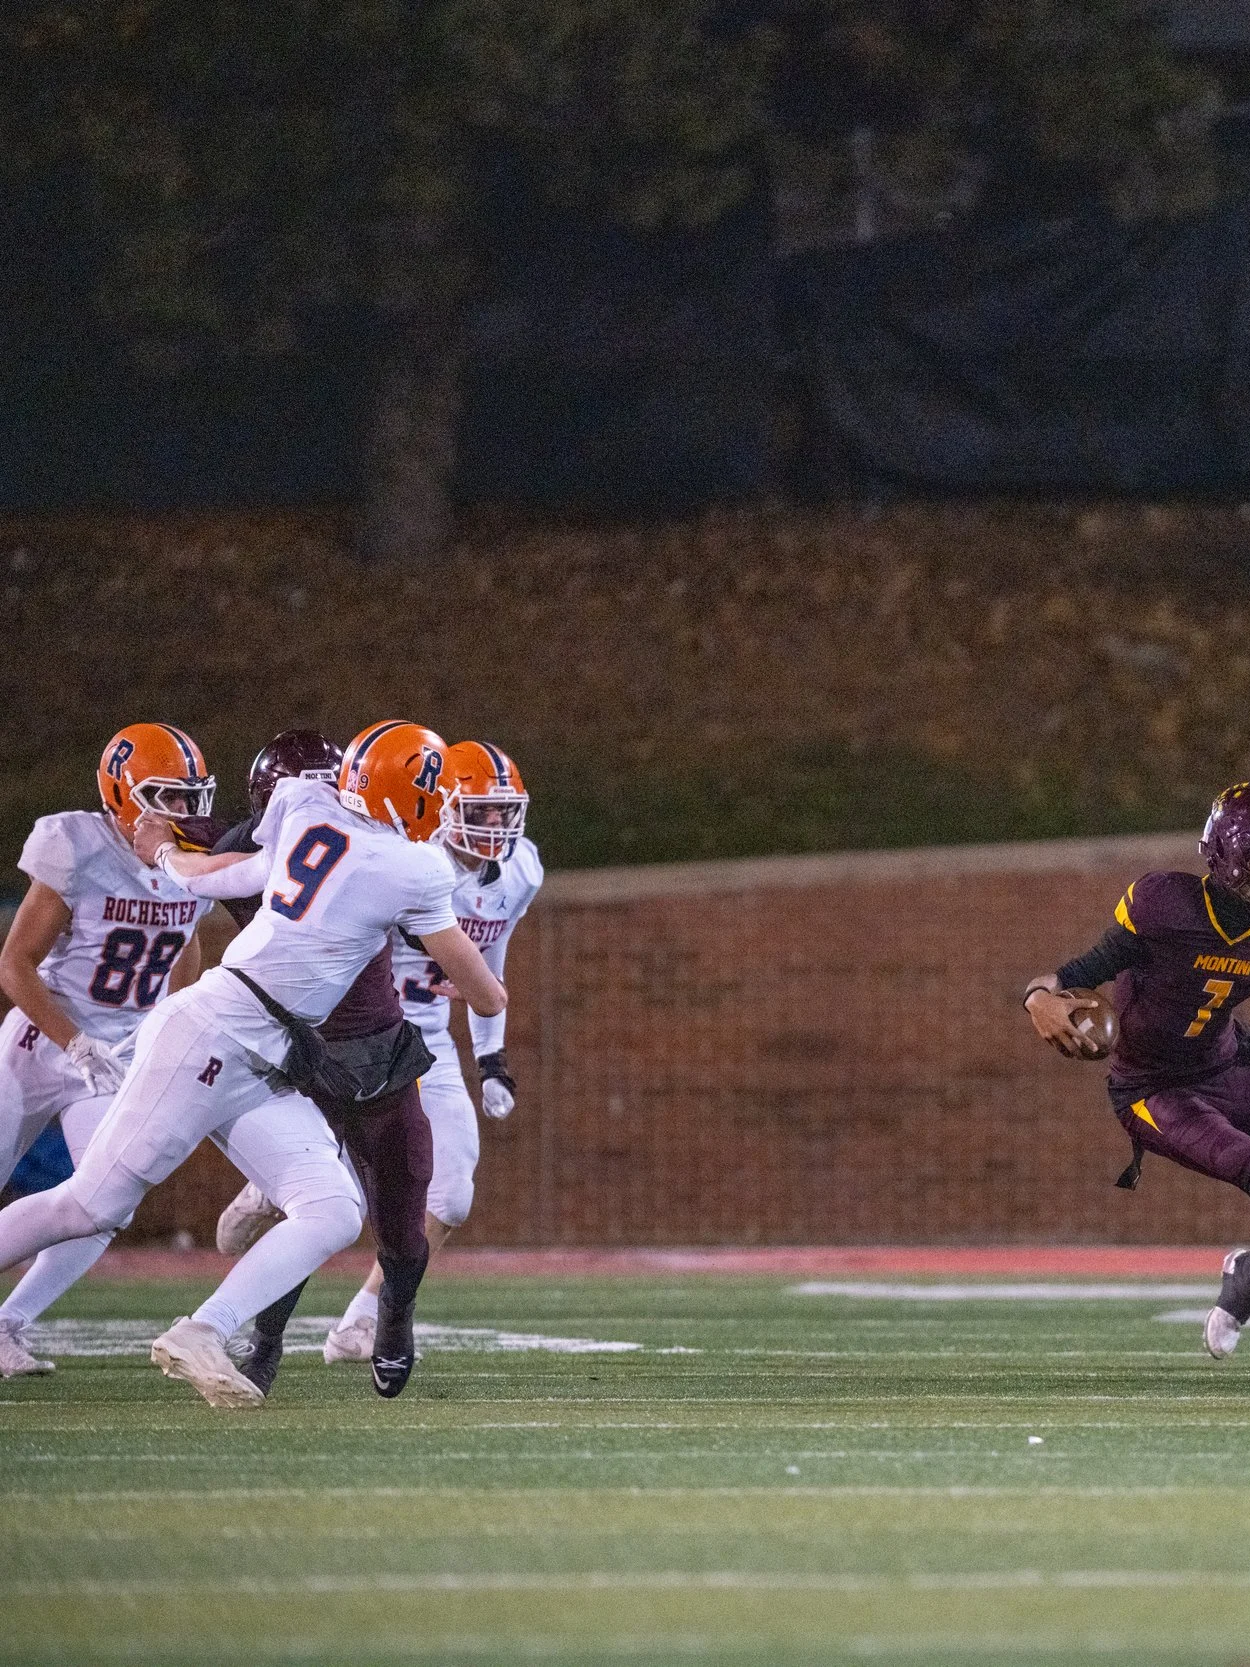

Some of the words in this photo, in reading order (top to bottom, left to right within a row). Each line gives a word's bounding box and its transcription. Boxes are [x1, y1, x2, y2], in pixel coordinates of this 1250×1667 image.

[107, 738, 135, 782] R
[412, 744, 443, 796] R
[359, 774, 370, 791] 9
[270, 823, 350, 922] 9
[103, 896, 197, 926] ROCHESTER
[88, 927, 186, 1009] 88
[1183, 979, 1234, 1038] 7
[18, 1024, 40, 1051] R
[197, 1056, 223, 1088] R
